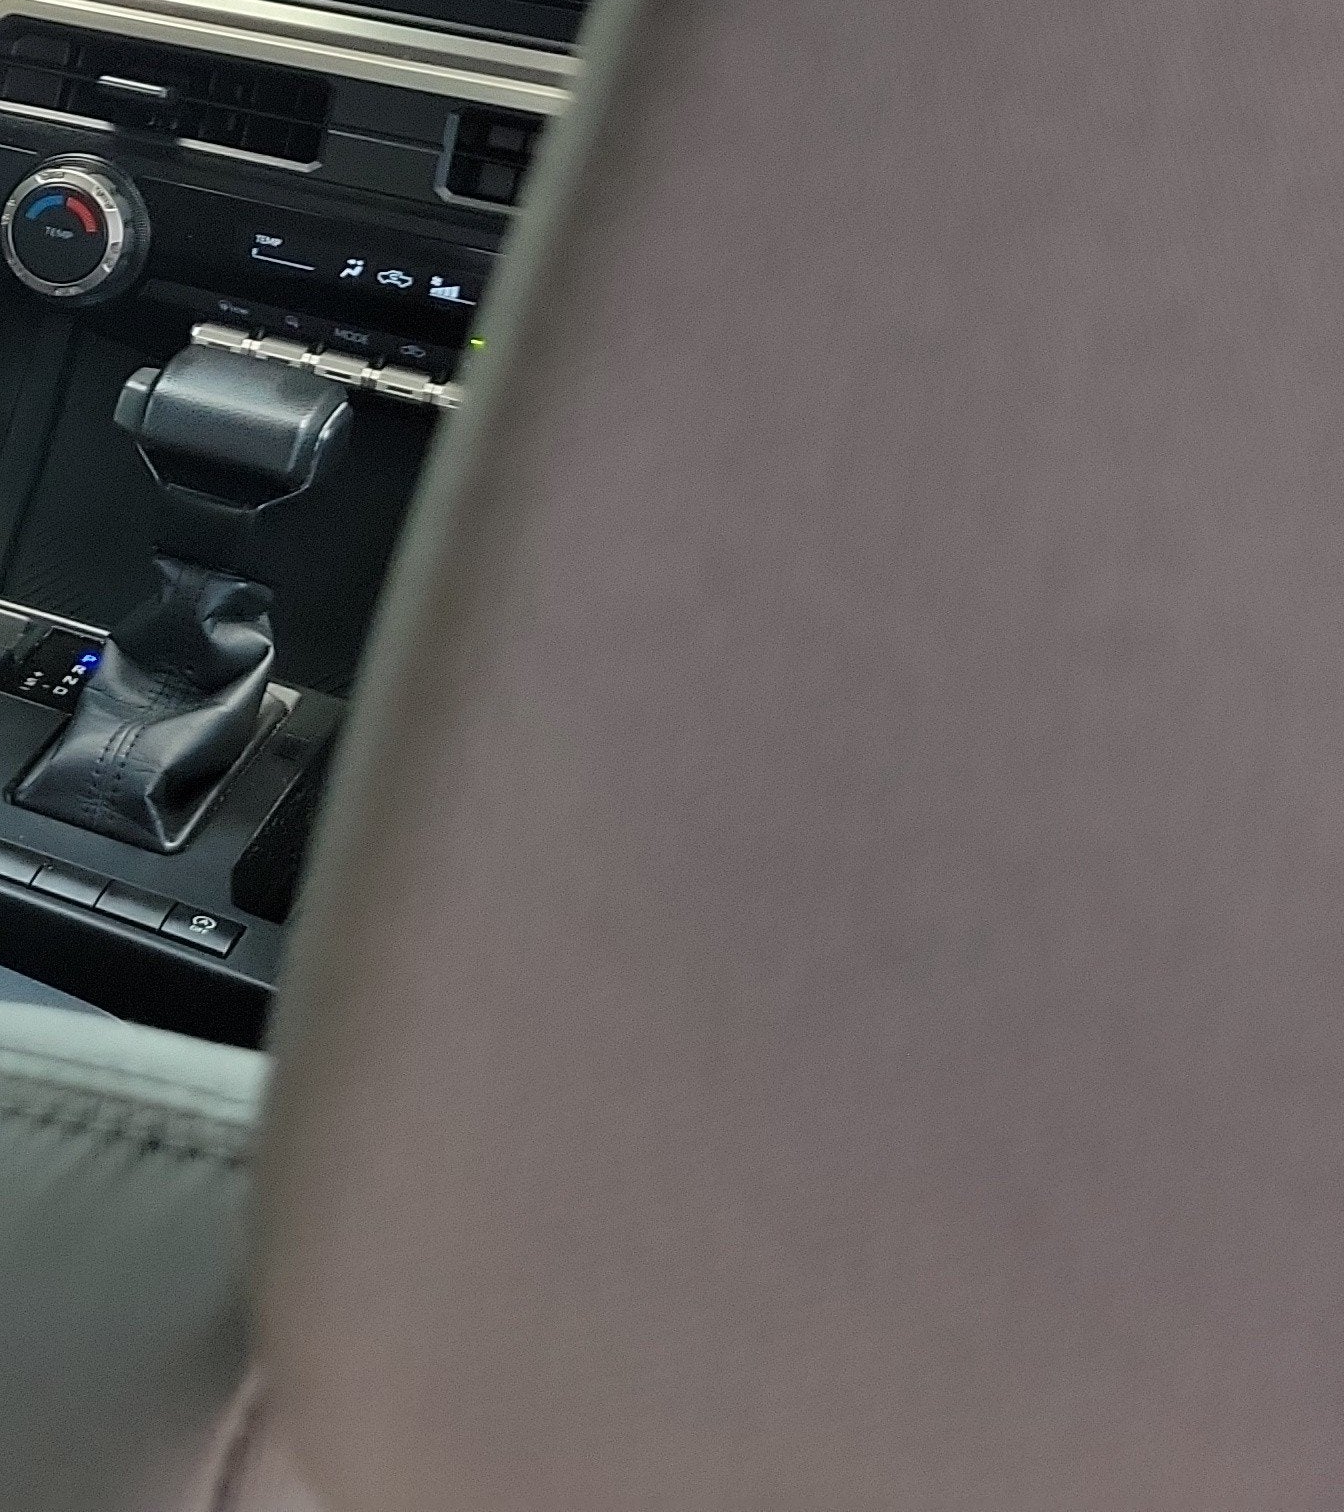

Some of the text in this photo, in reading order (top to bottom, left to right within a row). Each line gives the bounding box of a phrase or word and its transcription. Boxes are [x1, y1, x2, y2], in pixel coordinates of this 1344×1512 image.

[46, 225, 74, 239] TEMP
[255, 234, 283, 247] TEMP
[81, 654, 97, 663] P
[71, 664, 87, 675] R
[62, 675, 79, 685] N
[52, 686, 69, 695] D
